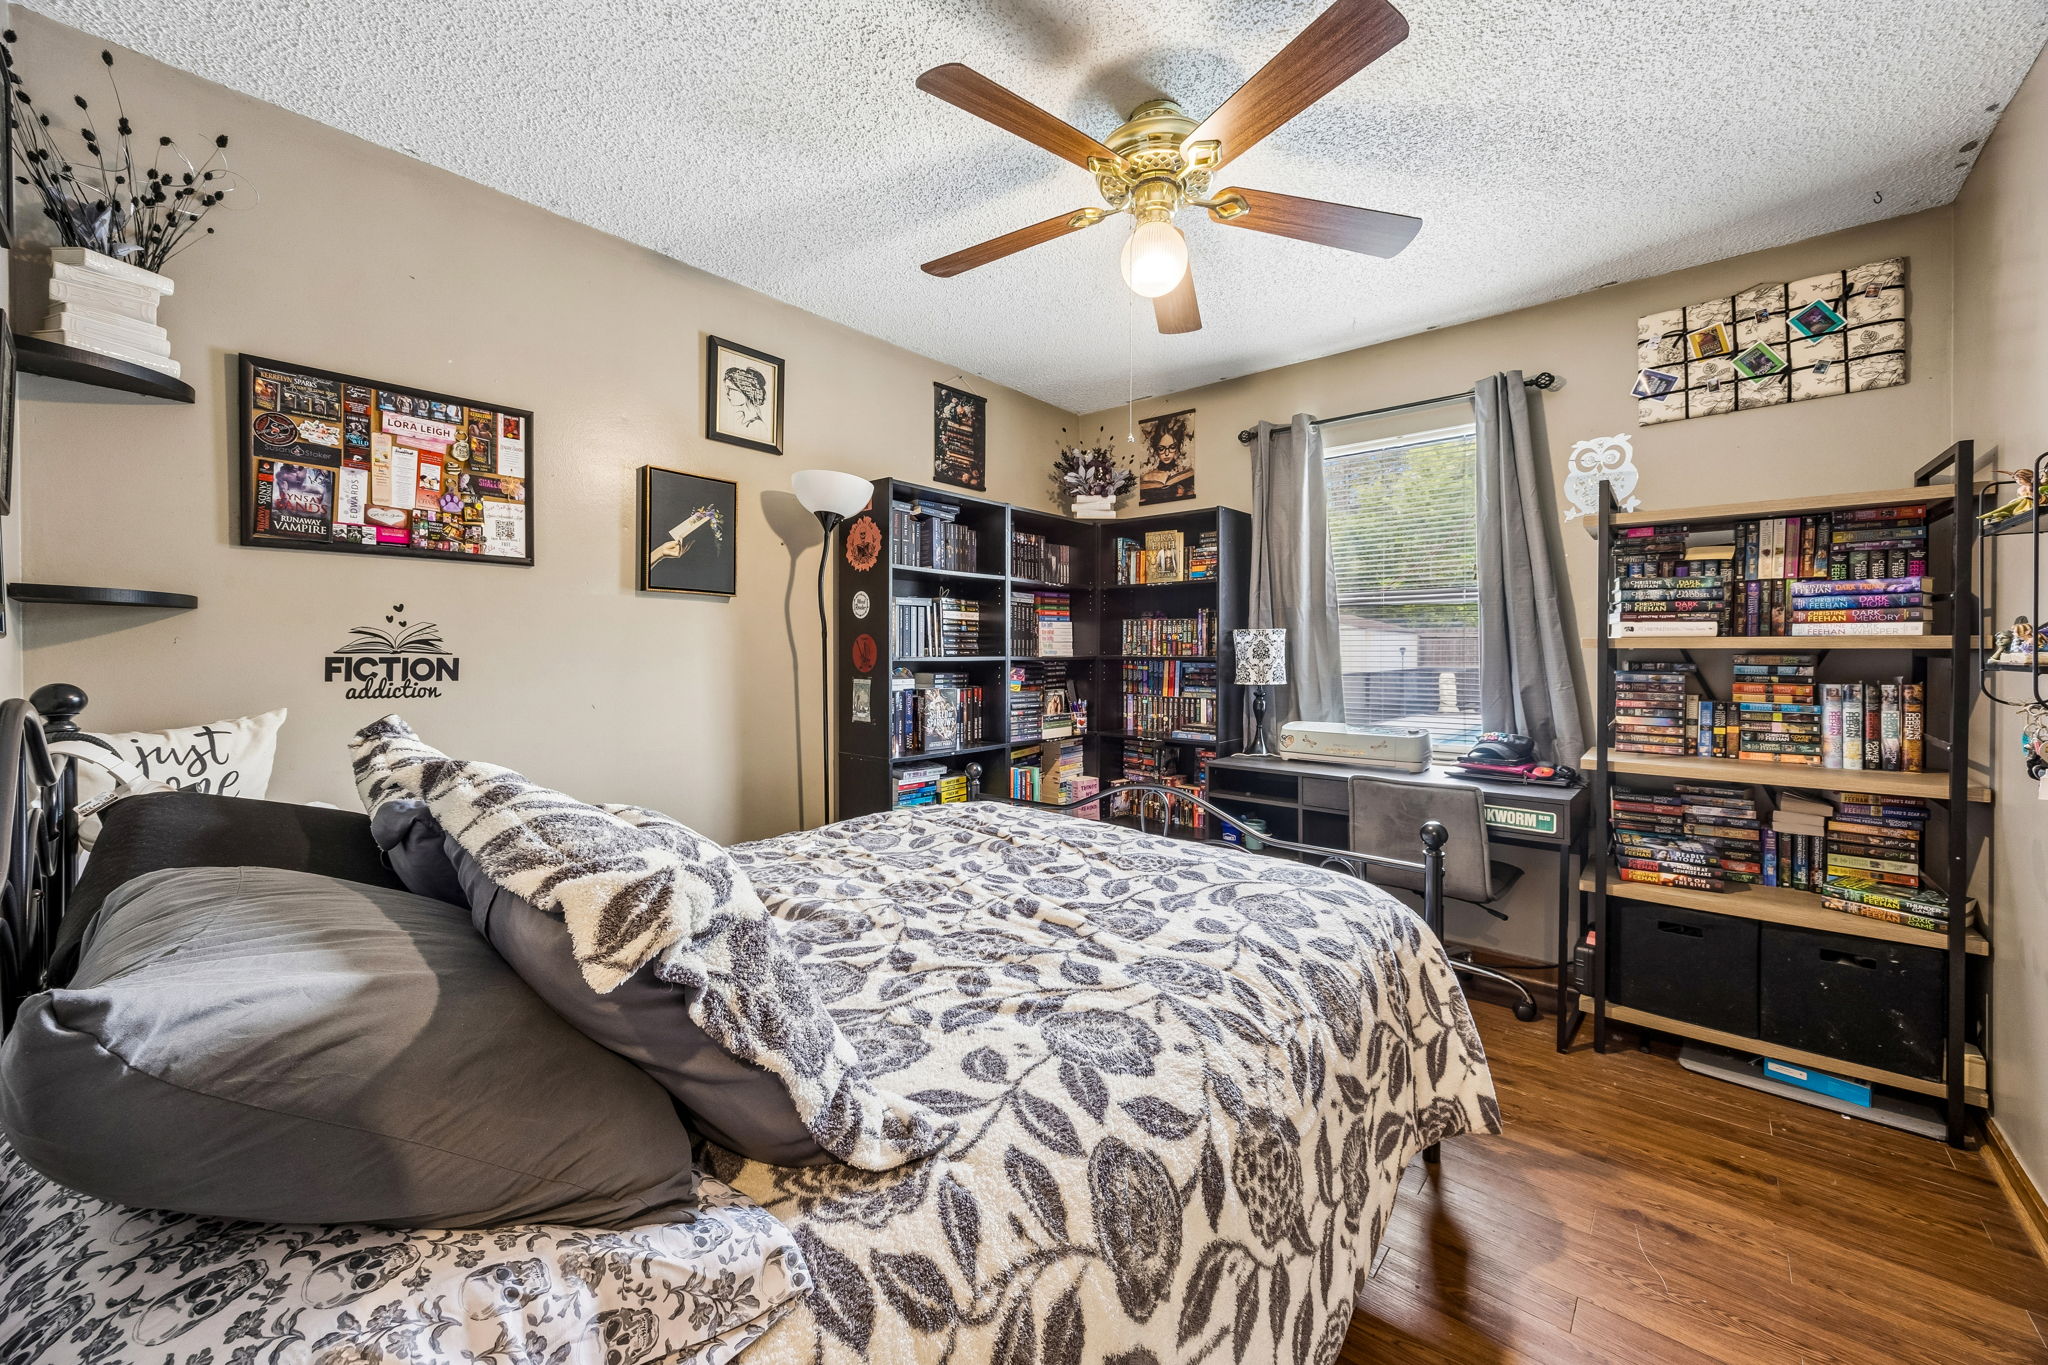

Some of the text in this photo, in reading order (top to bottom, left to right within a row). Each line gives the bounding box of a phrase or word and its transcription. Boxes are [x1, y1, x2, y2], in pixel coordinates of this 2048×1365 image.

[293, 378, 318, 389] SPARKS
[387, 418, 451, 438] LORA LEIGH
[303, 449, 333, 460] Stoker
[258, 481, 267, 505] SANDS
[350, 479, 359, 519] EDWARDS
[273, 520, 327, 535] VAMPIRE
[280, 515, 322, 526] RUNAWAY
[1835, 583, 1856, 591] DARK
[1809, 601, 1848, 609] FEEHAN
[1854, 614, 1900, 622] MEMORY
[324, 656, 460, 683] FICTION
[345, 677, 442, 700] addiction
[1845, 711, 1855, 738] FEEHAN
[1853, 711, 1861, 738] CHRISTINE
[1905, 712, 1914, 740] FEEHAN
[1912, 712, 1921, 740] CHRISTINE
[130, 725, 232, 778] just
[1865, 742, 1873, 760] GAME
[1484, 809, 1537, 828] KWORM
[1624, 845, 1705, 859] CHRISTINE DEADLY
[1675, 857, 1707, 865] STORMS
[1628, 874, 1659, 882] FEEHAN
[1672, 868, 1697, 876] SUNRISE
[1863, 893, 1942, 913] CHRISTINE THUNDER
[1863, 898, 1935, 917] FEEHAN GAME
[1861, 910, 1935, 931] FEEHAN GAME
[1907, 915, 1934, 925] TOXIC
